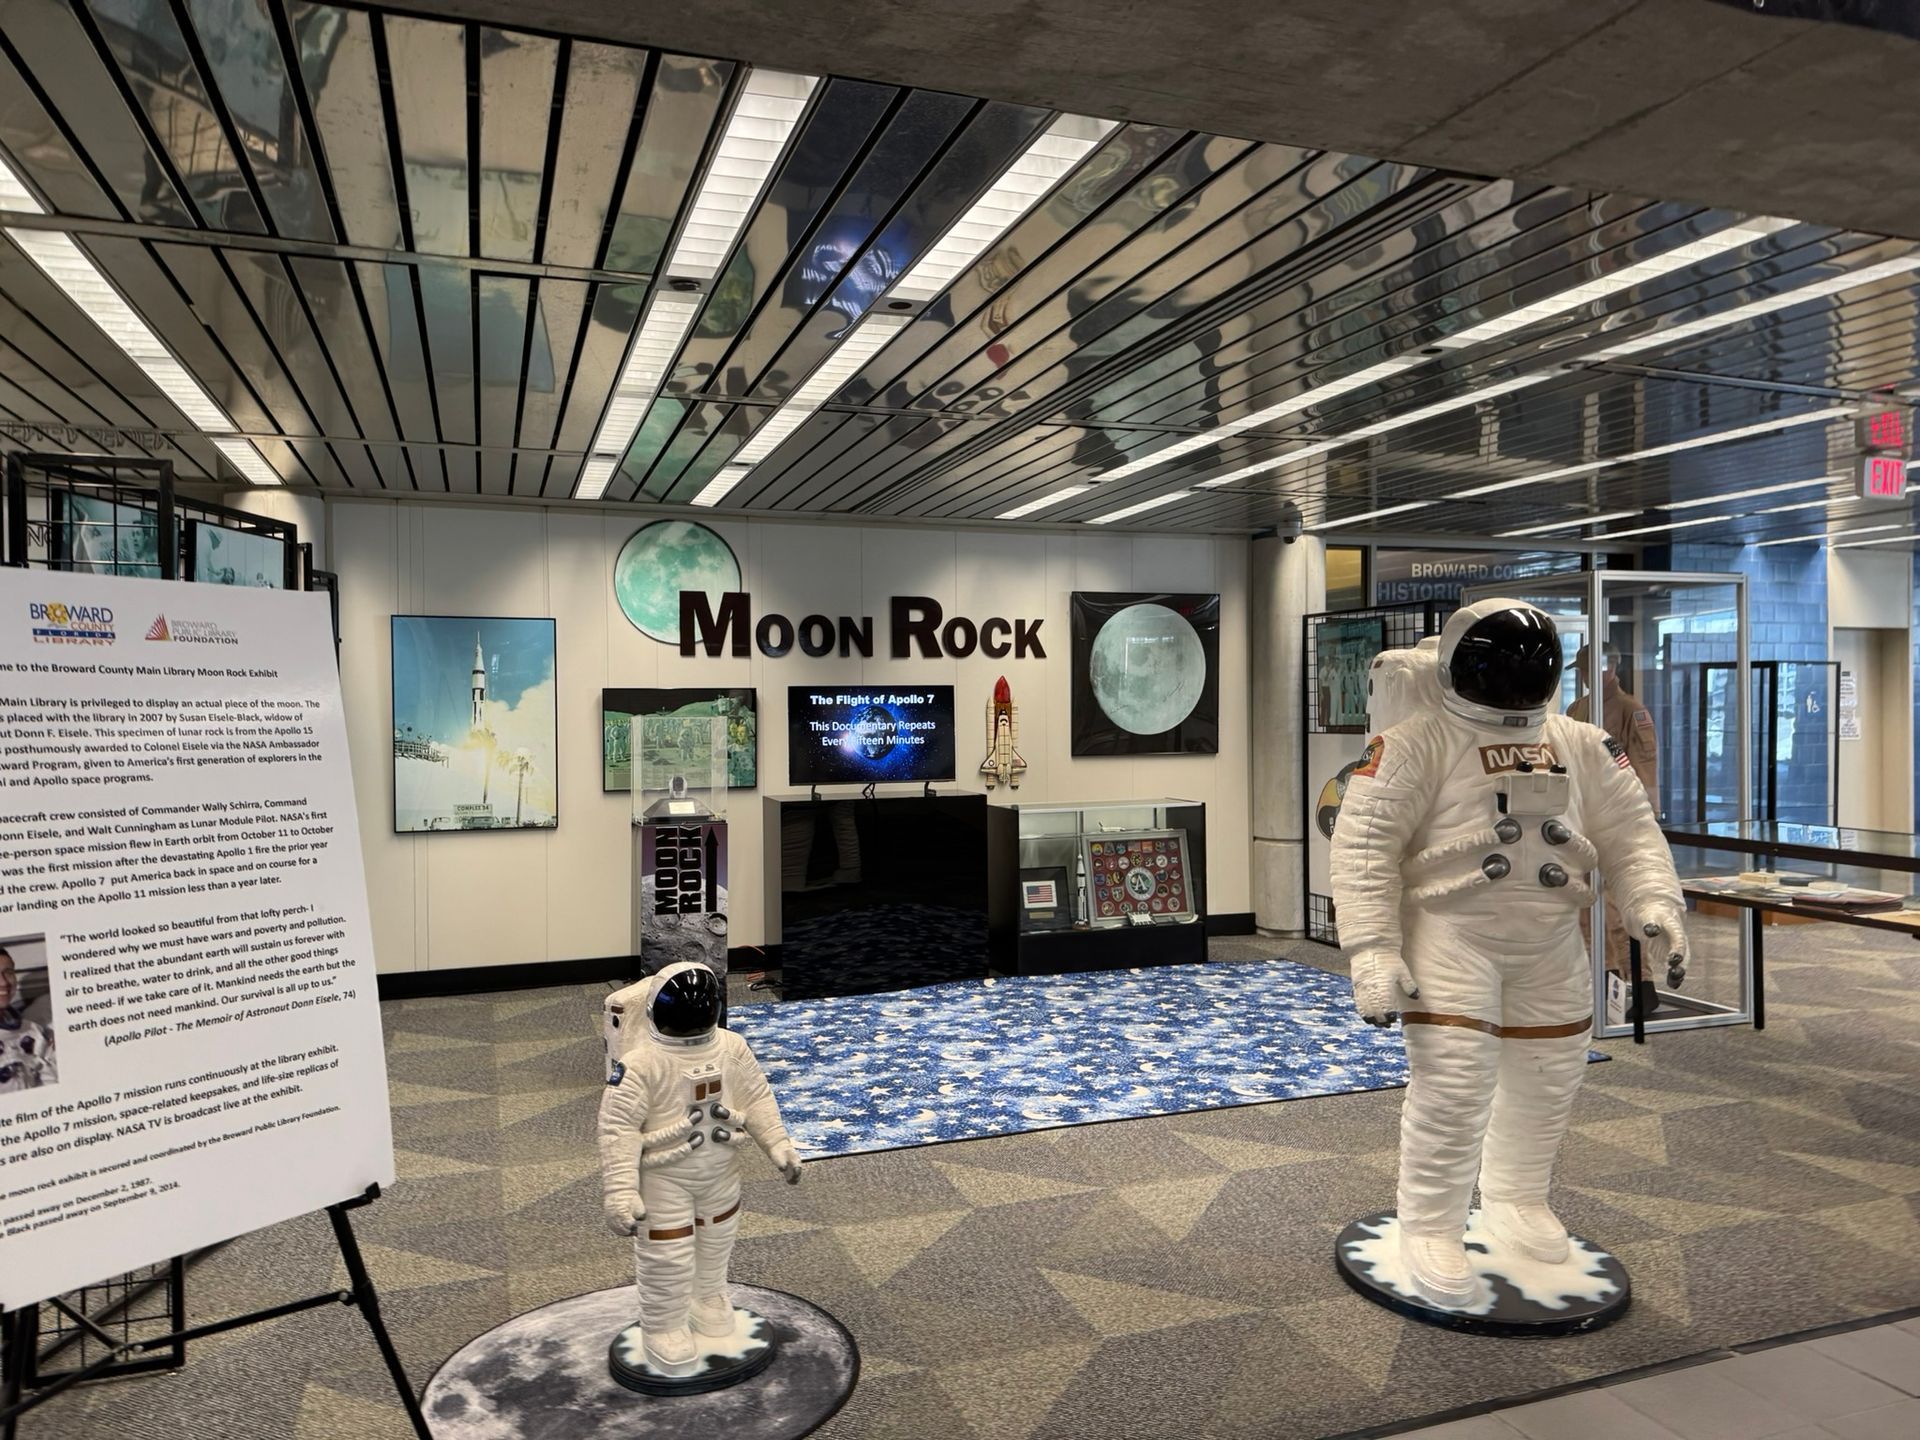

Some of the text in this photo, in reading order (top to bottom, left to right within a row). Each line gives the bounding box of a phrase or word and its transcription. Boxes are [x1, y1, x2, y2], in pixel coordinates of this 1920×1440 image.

[1870, 458, 1904, 496] EXIT
[1412, 562, 1488, 579] BROWARD
[678, 590, 1048, 660] MOON ROCK
[33, 636, 114, 646] LIBRARY
[36, 630, 116, 639] FLORIDA
[173, 636, 238, 645] FOUNDATION
[16, 663, 28, 672] to
[30, 663, 49, 672] the
[51, 664, 96, 674] Broward
[98, 665, 134, 676] County
[136, 666, 162, 675] Main
[163, 667, 195, 678] Library
[197, 668, 224, 677] Moon
[226, 669, 247, 677] Rock
[249, 669, 278, 678] Exhibit
[30, 698, 67, 709] Library
[70, 698, 78, 707] is
[80, 698, 131, 709] privileged
[132, 699, 144, 708] to
[145, 699, 179, 709] display
[195, 699, 222, 708] actual
[224, 699, 248, 709] piece
[249, 699, 258, 708] of
[260, 700, 275, 708] the
[305, 700, 320, 708] The
[810, 694, 935, 706] The Flight of Apollo 7
[7, 713, 43, 724] placed
[46, 713, 70, 722] with
[72, 713, 90, 722] the
[92, 713, 126, 724] library
[128, 713, 138, 722] in
[140, 713, 163, 722] 2007
[165, 713, 177, 724] by
[179, 713, 206, 722] Susan
[264, 713, 293, 721] widow
[294, 713, 303, 721] of
[810, 721, 936, 732] This Documentary Repeats
[14, 726, 313, 739] Donn F. Eisele. This specimen of lunar rock is from the Apollo 15
[886, 736, 925, 745] Minutes
[4, 740, 319, 756] posthumously awarded to Colonel Eisele via the NASA Ambassador
[1486, 744, 1557, 768] NASA
[32, 753, 322, 771] Program, given to America's first generation of explorers in the
[9, 774, 153, 787] and Apollo space programs.
[49, 797, 307, 821] crew consisted of Commander Wally Schirra, Command
[27, 829, 62, 839] Eisele,
[65, 826, 85, 837] and
[87, 825, 112, 835] Walt
[114, 822, 176, 834] Cunningham
[191, 820, 217, 828] Lunar
[219, 816, 254, 826] Module
[255, 815, 278, 823] Pilot.
[280, 812, 310, 822] NASA's
[311, 811, 327, 820] first
[655, 826, 678, 915] MOON
[679, 825, 702, 914] ROCK
[88, 928, 119, 941] world
[121, 924, 156, 936] looked
[158, 924, 170, 932] so
[171, 916, 214, 930] beautiful
[216, 915, 239, 924] from
[240, 912, 259, 921] that
[260, 908, 281, 918] lofty
[61, 916, 346, 962] wondered why we must have wars and poverty and pollution.
